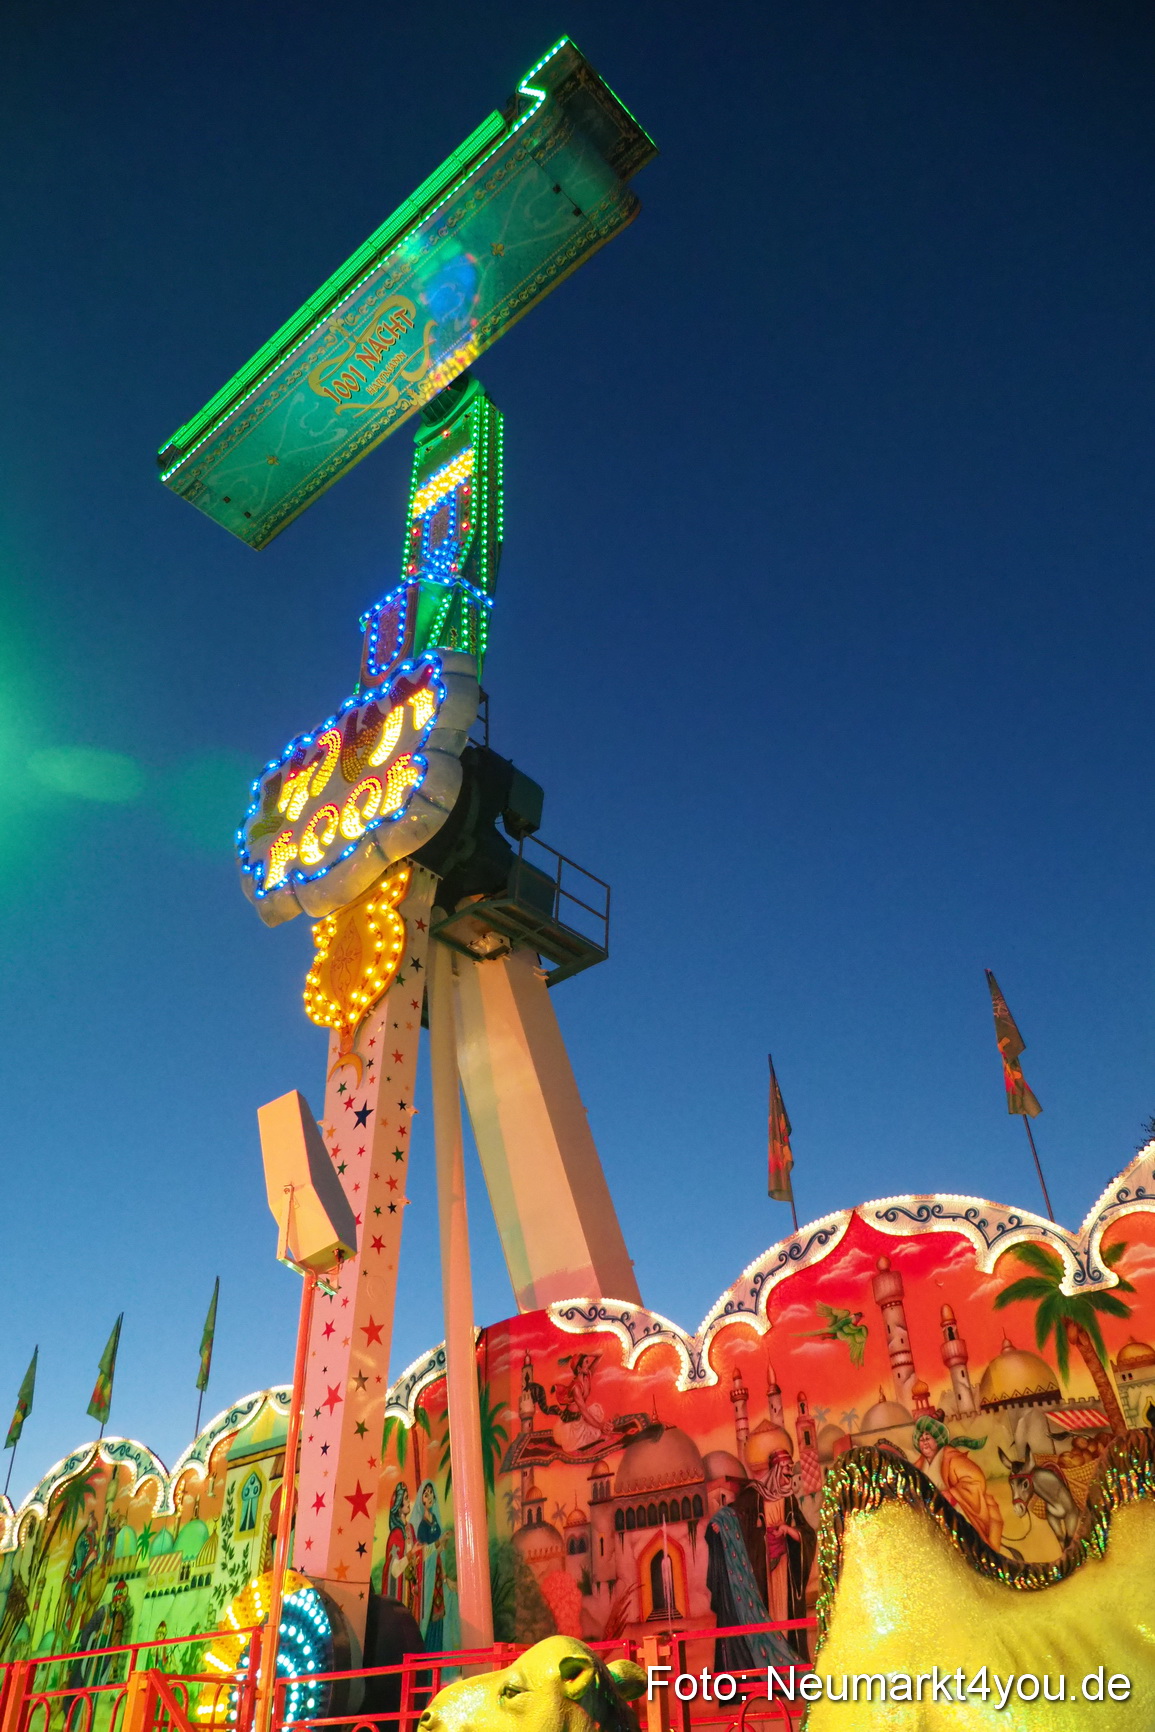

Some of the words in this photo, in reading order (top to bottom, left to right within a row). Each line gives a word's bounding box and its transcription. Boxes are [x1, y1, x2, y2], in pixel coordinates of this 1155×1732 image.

[324, 364, 367, 404] 1001
[355, 308, 414, 370] NACHT
[367, 352, 407, 395] HARTMANN
[265, 752, 418, 891] 1001
